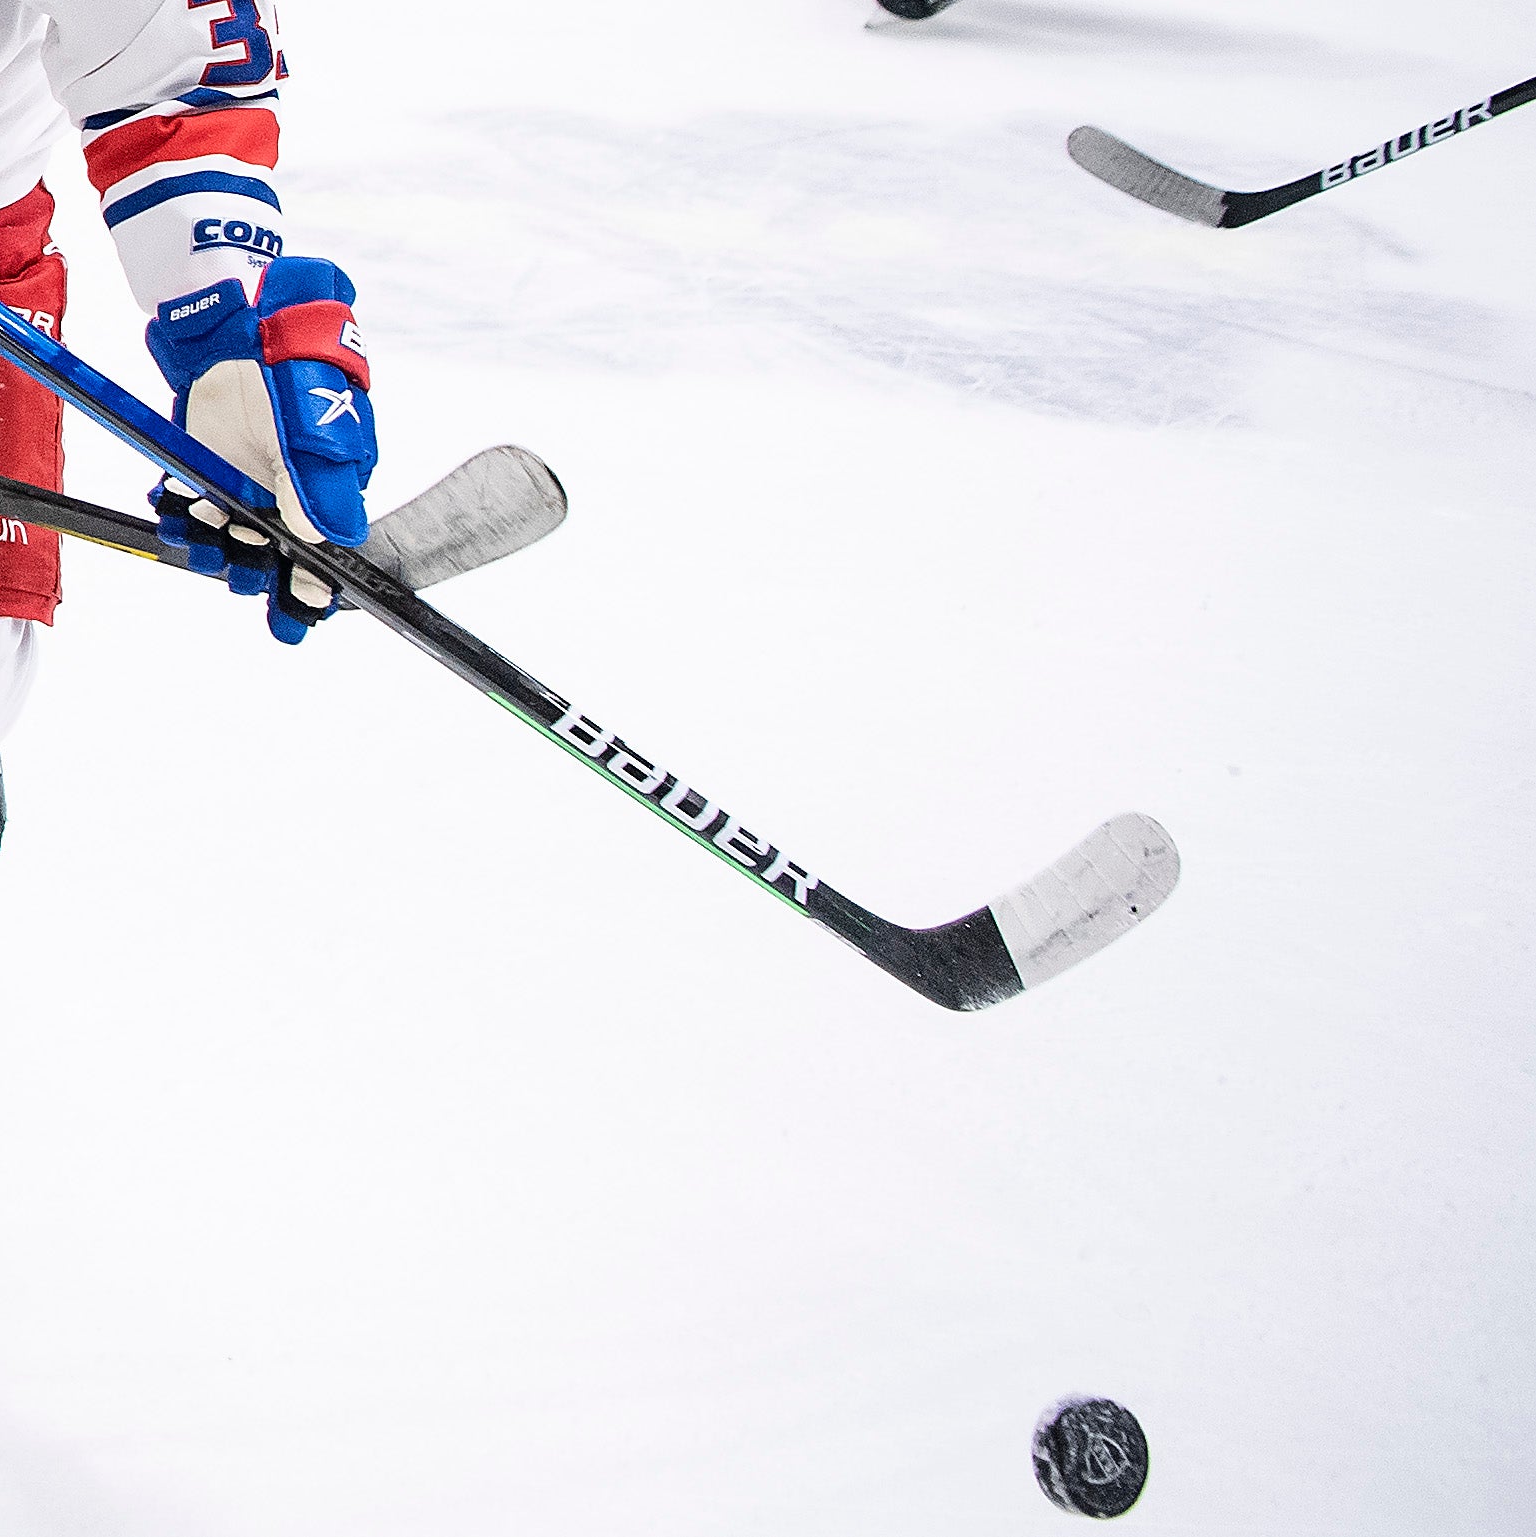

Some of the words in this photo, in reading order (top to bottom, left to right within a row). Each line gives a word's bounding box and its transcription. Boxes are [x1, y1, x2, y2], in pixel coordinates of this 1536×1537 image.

[1320, 95, 1494, 193] BAUER
[169, 291, 222, 323] BAUER
[550, 702, 820, 907] BAUER
